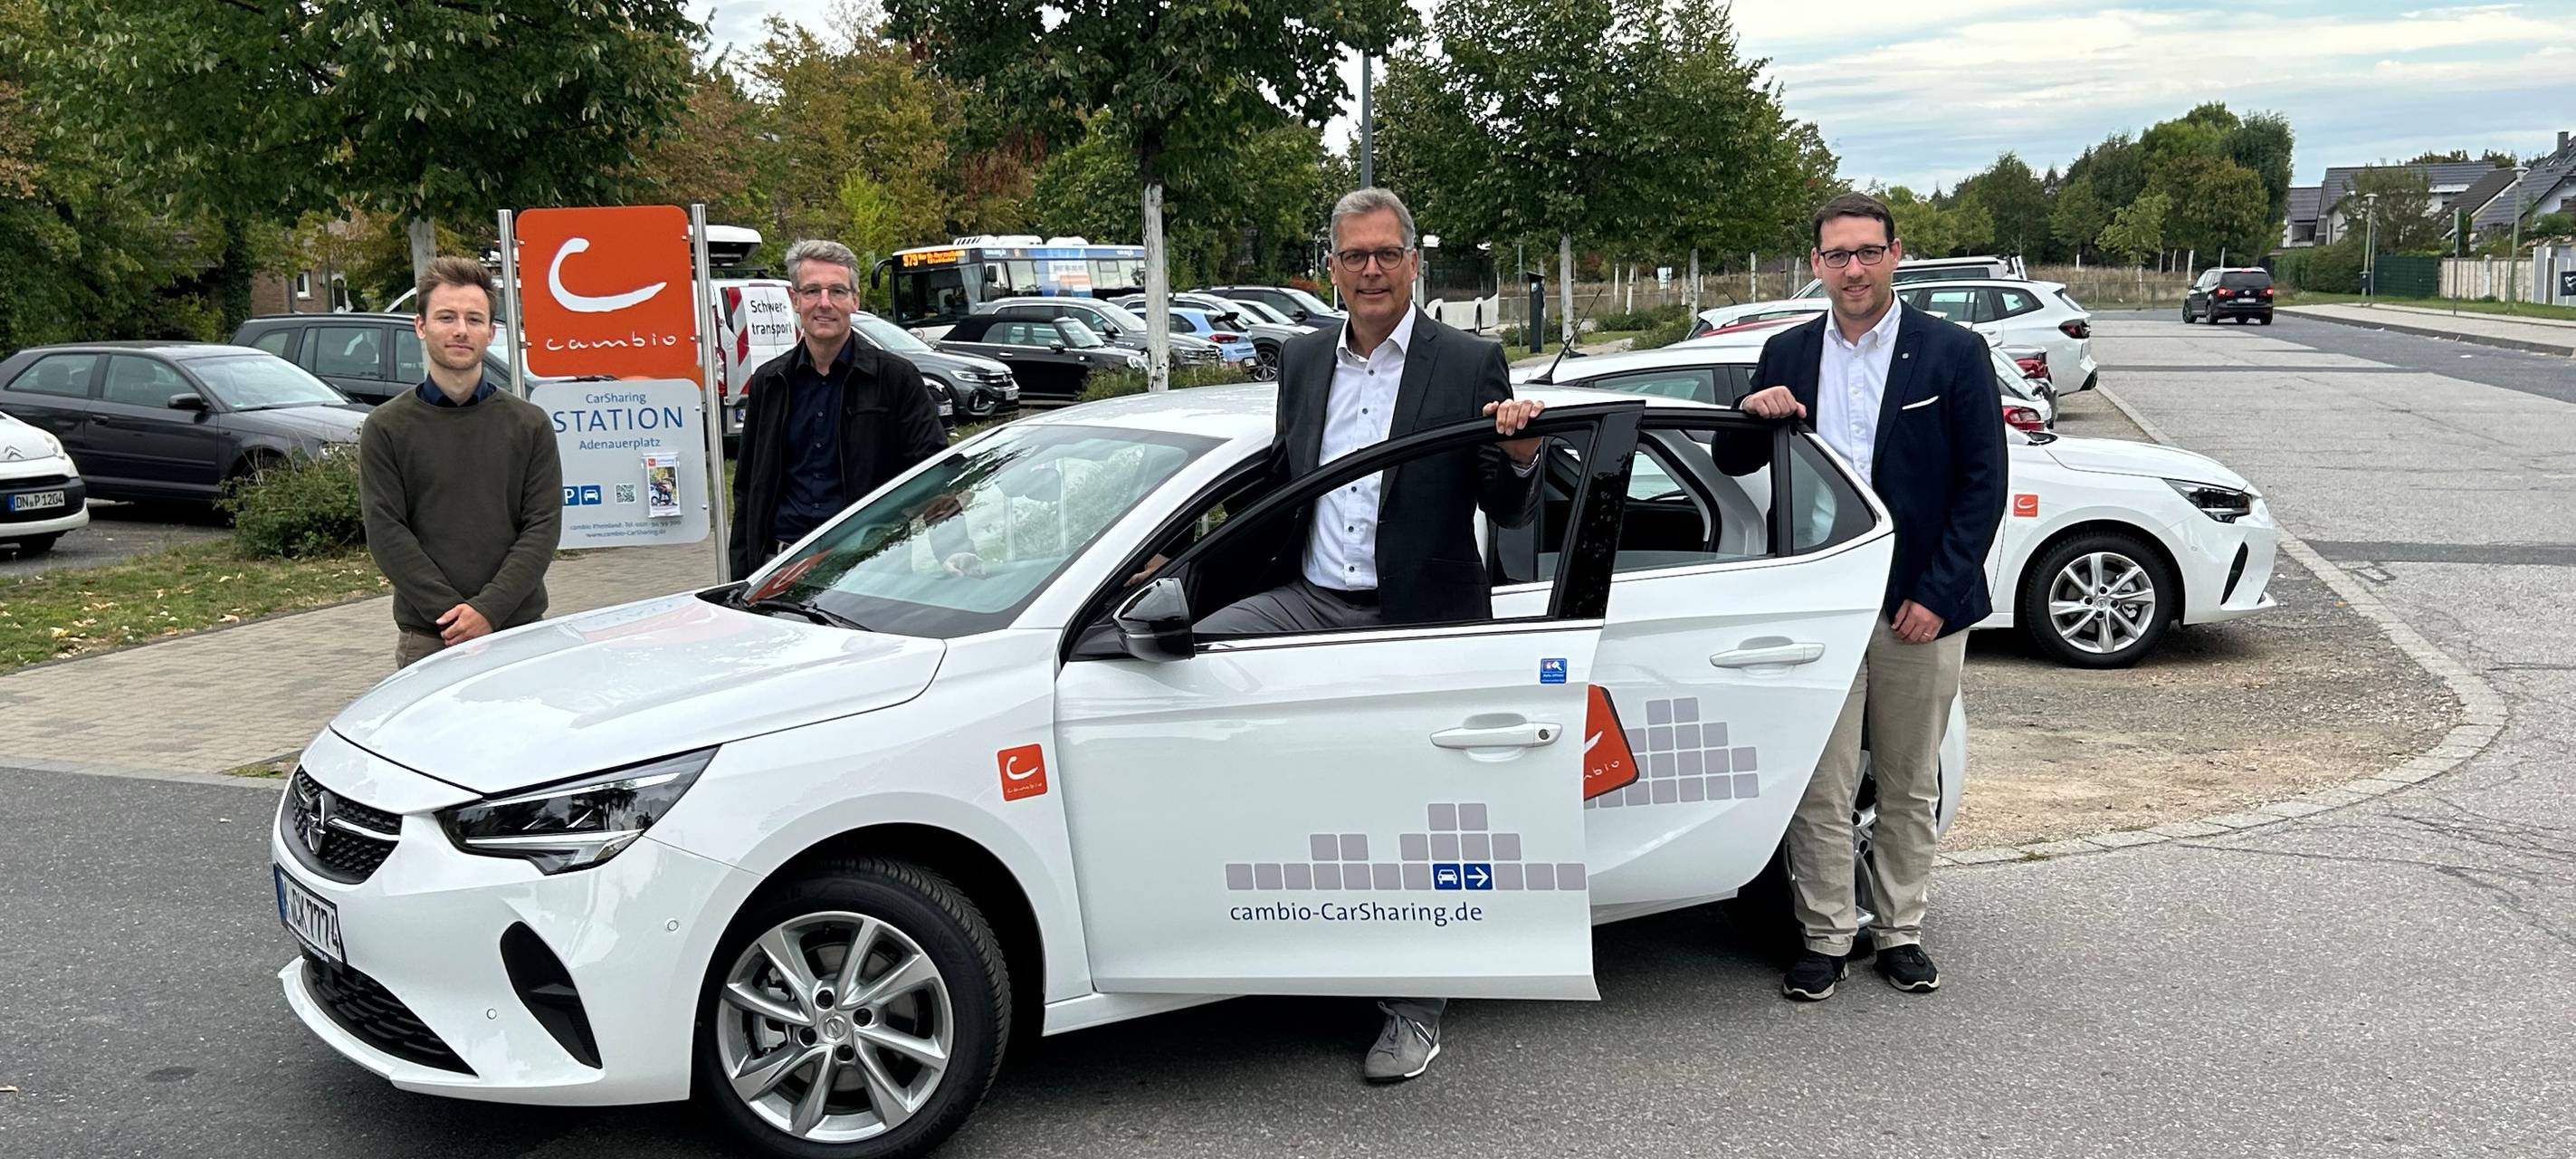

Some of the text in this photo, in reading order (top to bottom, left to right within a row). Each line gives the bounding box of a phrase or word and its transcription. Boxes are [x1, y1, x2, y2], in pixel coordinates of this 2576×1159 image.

[750, 300, 787, 313] Schwer-
[751, 322, 793, 338] transport
[546, 330, 677, 351] cambio
[586, 392, 646, 405] CarSharing
[553, 406, 683, 433] STATION
[578, 436, 661, 451] Adenauerplatz
[564, 488, 575, 504] P
[1230, 902, 1483, 927] cambio-CarSharing.de
